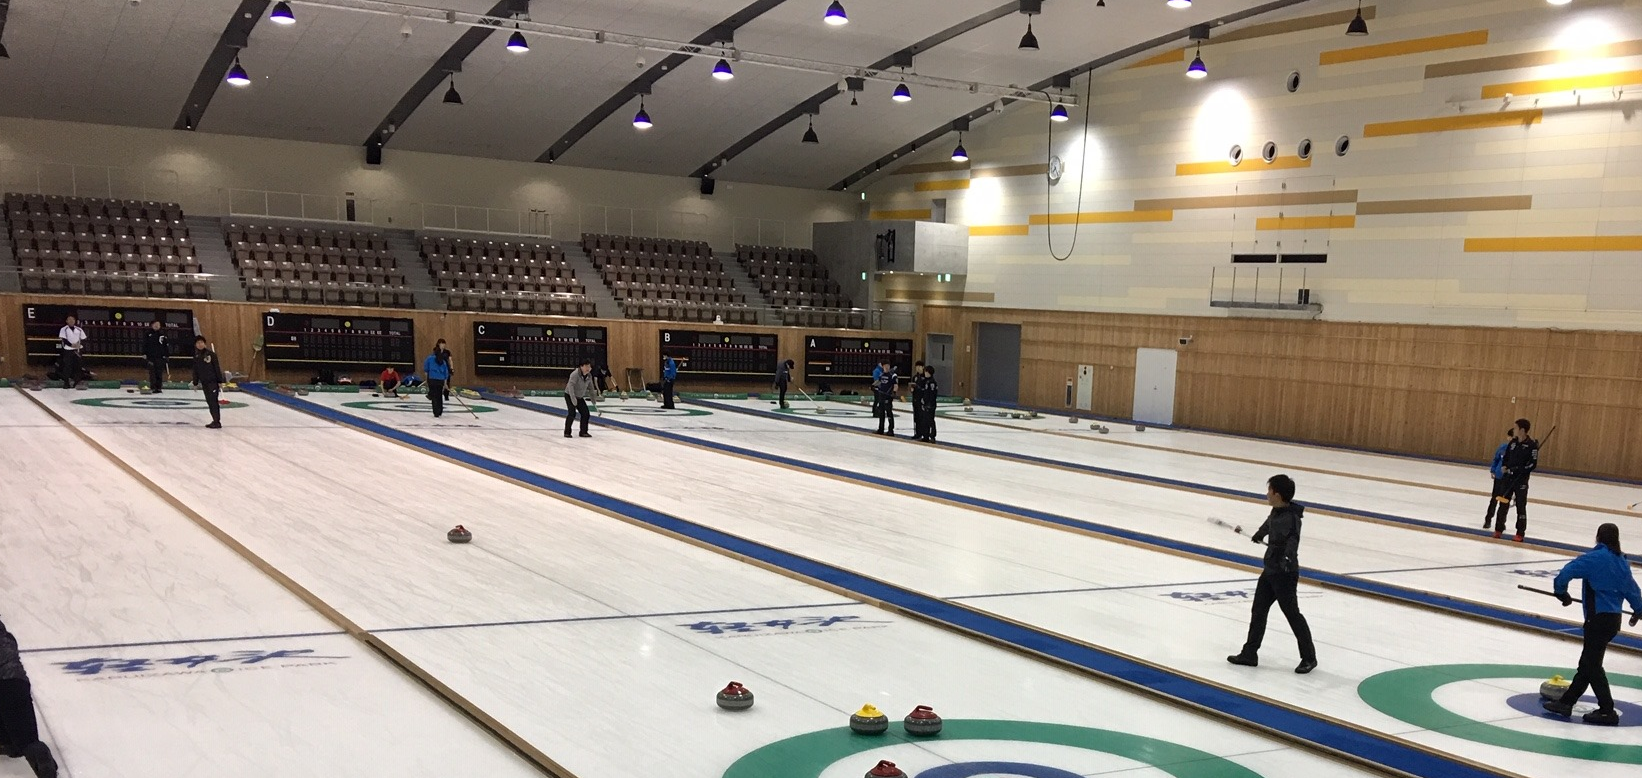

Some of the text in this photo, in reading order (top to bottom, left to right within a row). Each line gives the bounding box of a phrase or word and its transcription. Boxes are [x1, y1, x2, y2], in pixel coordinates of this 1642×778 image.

[27, 308, 36, 319] E
[267, 316, 275, 327] D
[478, 325, 485, 335] C
[664, 333, 671, 342] B
[810, 339, 816, 348] A
